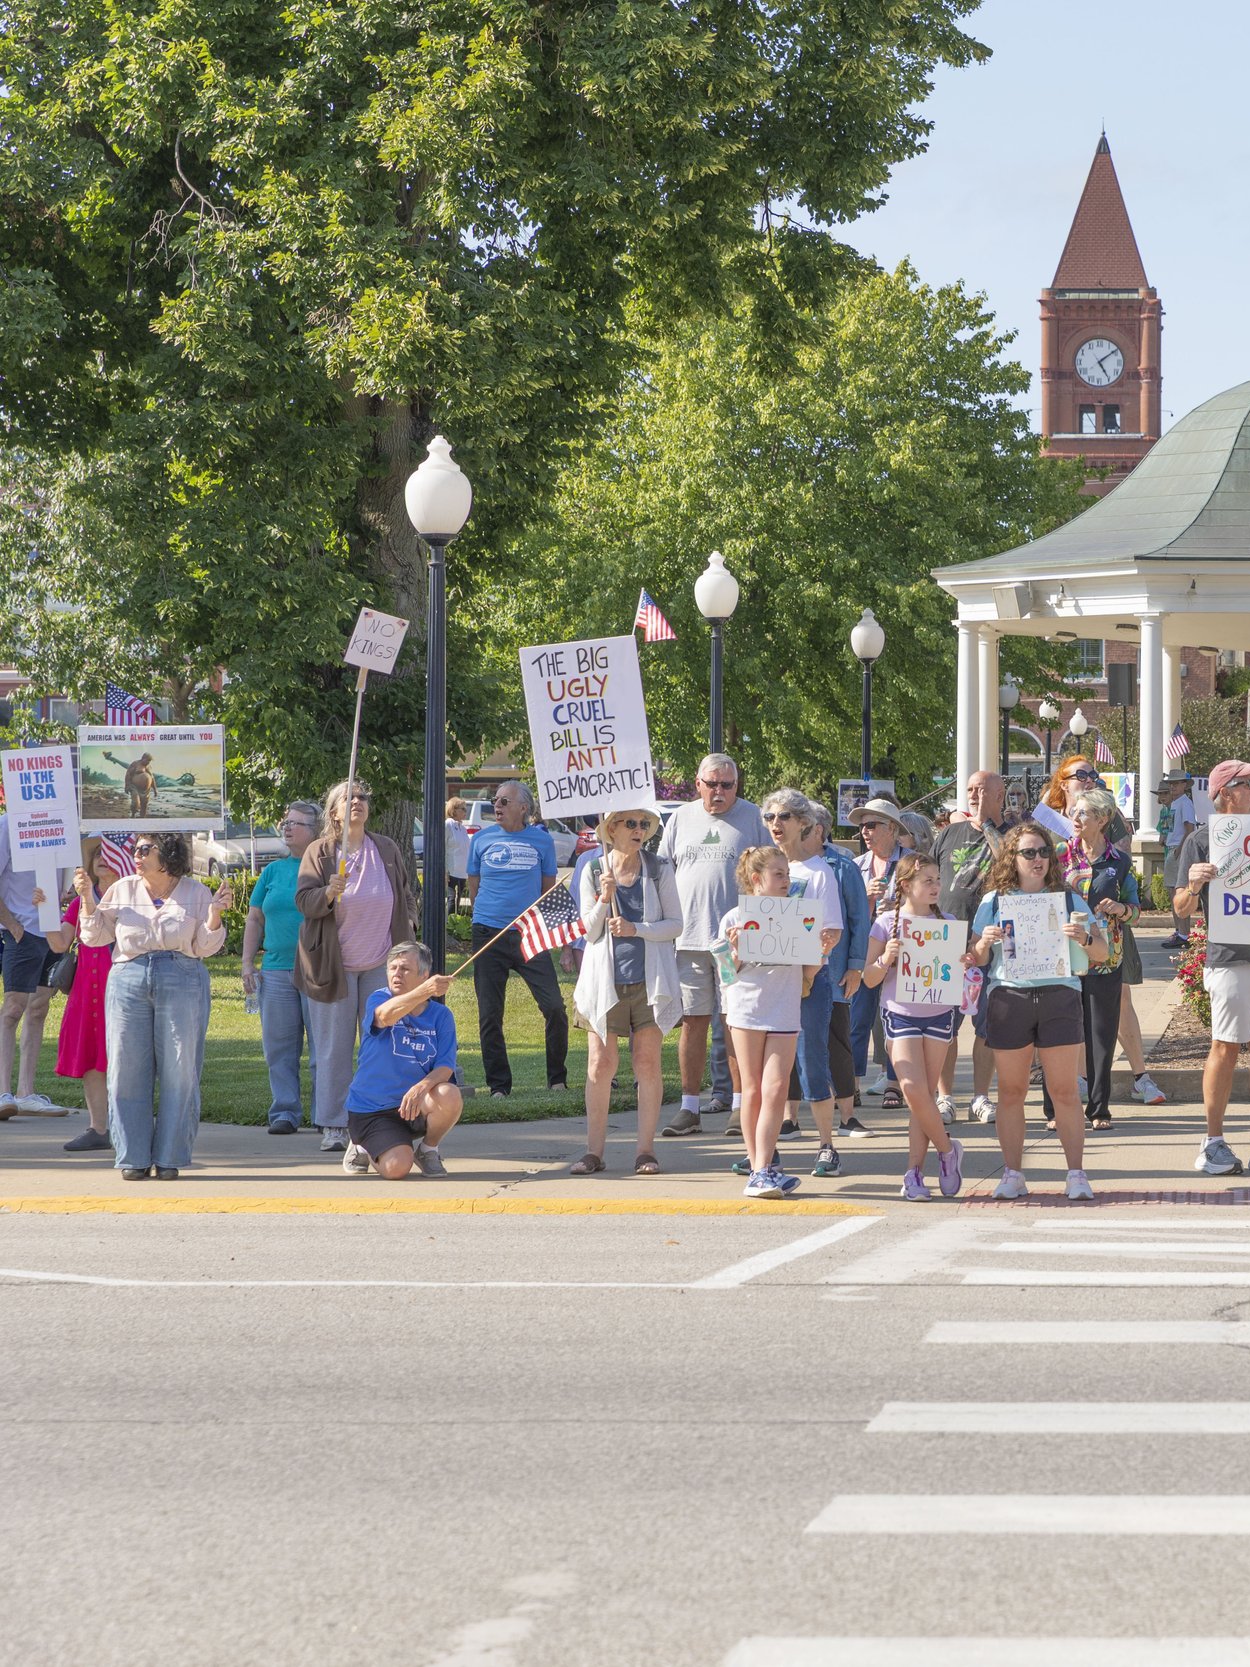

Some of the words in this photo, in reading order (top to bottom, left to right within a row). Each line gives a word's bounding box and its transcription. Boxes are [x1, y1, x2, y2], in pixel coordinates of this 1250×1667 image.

[368, 620, 395, 637] NO
[532, 651, 566, 678] THE
[576, 646, 608, 674] BIG
[547, 674, 608, 702] UGLY
[553, 699, 615, 725] CRUEL
[550, 728, 588, 751] BILL
[594, 725, 616, 744] IS
[8, 758, 24, 772] NO
[26, 756, 63, 771] KINGS
[567, 746, 616, 772] ANTI
[20, 772, 31, 784] IN
[33, 770, 55, 784] THE
[544, 761, 650, 802] DEMOCRATIC!
[21, 784, 57, 800] USA
[19, 827, 65, 839] DEMOCRACY
[1216, 820, 1237, 845] KINGS
[20, 841, 35, 849] NOW
[42, 838, 67, 847] ALWAYS
[745, 897, 804, 916] LOVE
[1002, 898, 1009, 910] A
[1017, 912, 1040, 922] Place
[903, 919, 948, 947] Equal
[747, 933, 800, 957] LOVE
[902, 952, 951, 987] Rigts
[1005, 960, 1056, 978] Resistance
[905, 982, 918, 1002] 4
[922, 988, 942, 1004] ALL
[402, 1036, 425, 1051] HRE!
